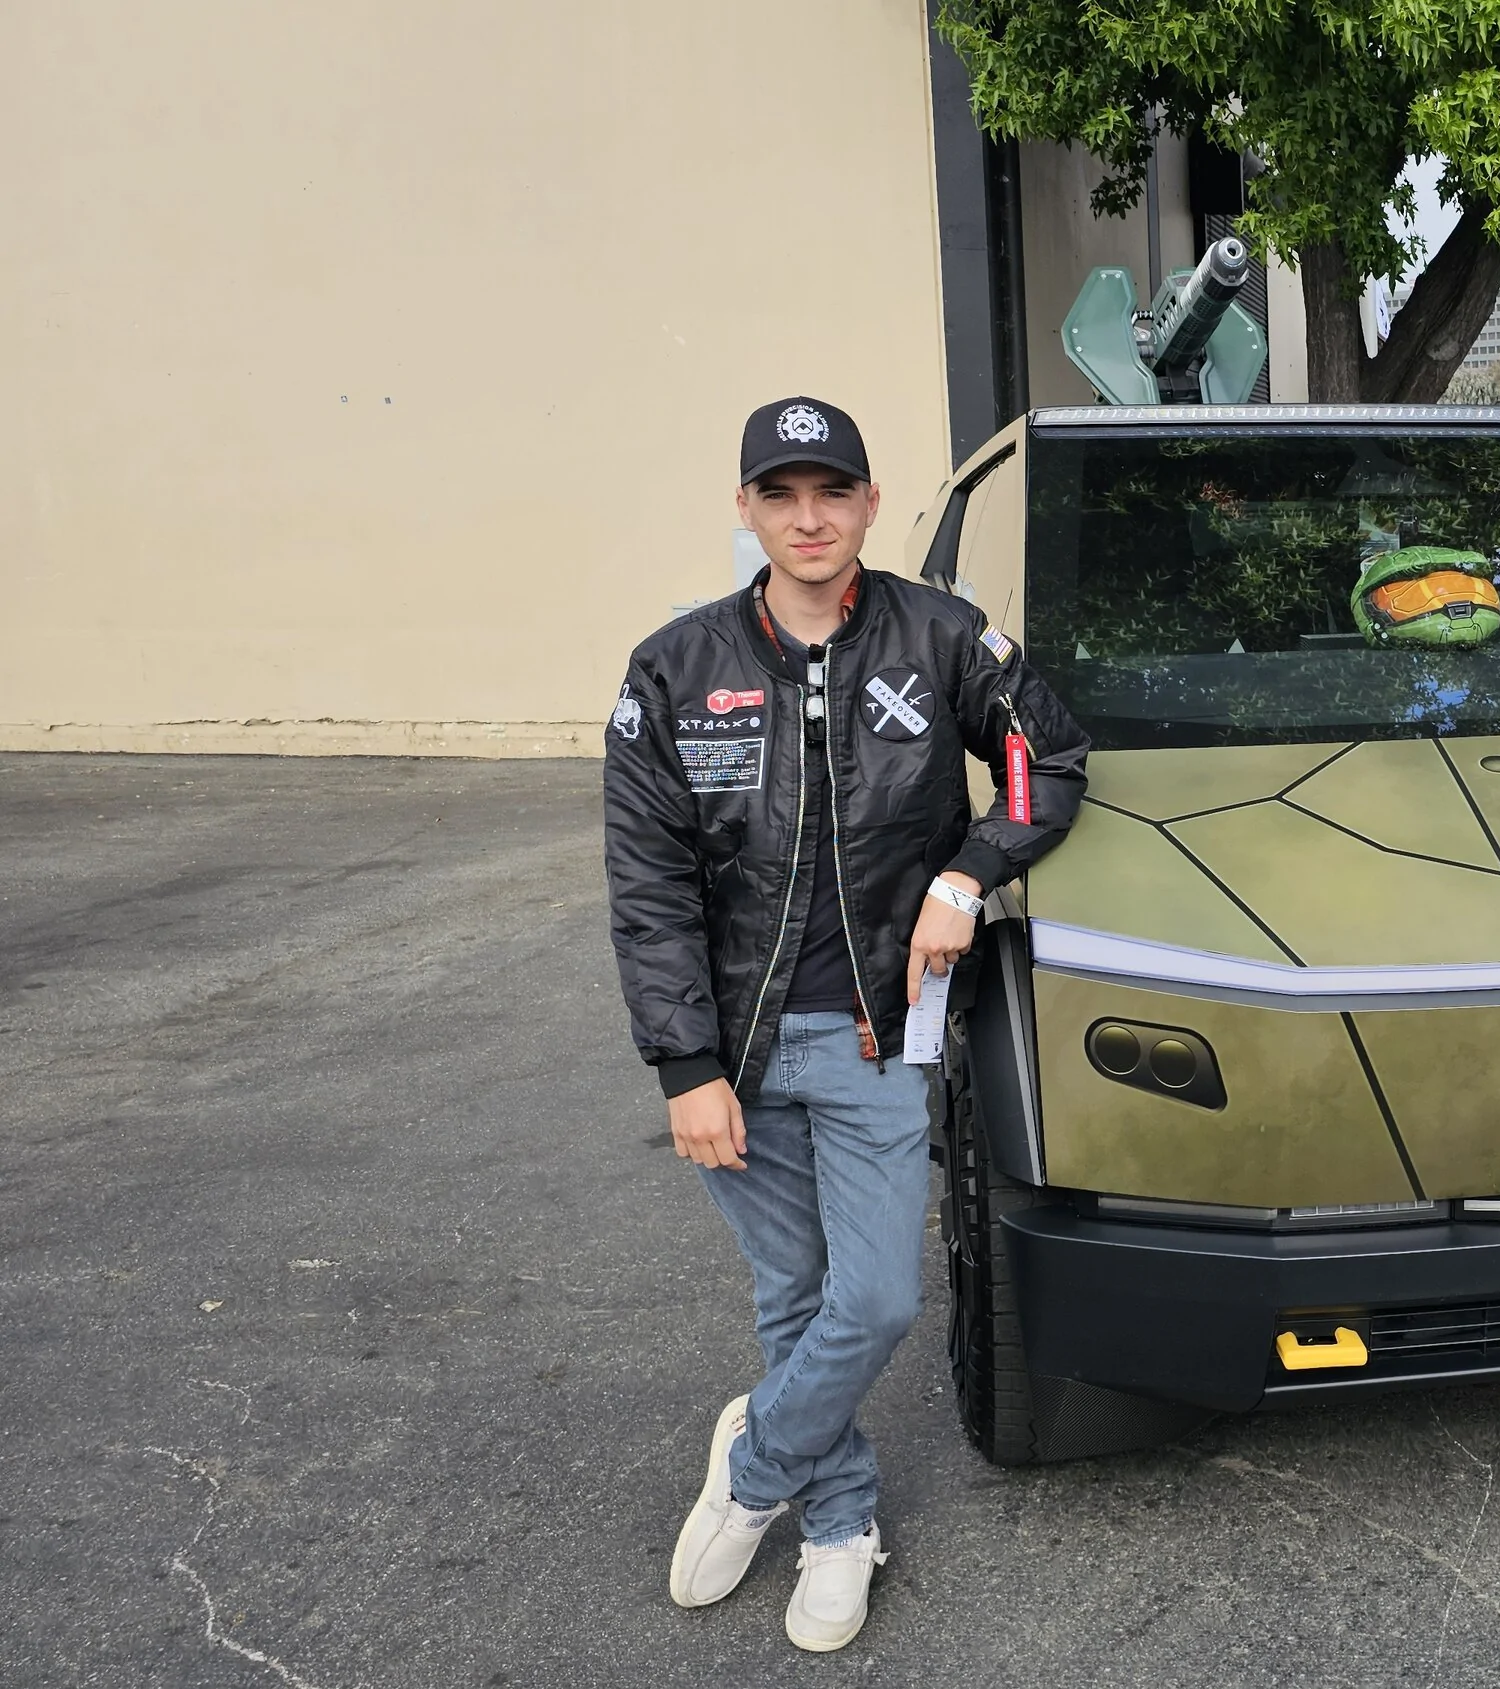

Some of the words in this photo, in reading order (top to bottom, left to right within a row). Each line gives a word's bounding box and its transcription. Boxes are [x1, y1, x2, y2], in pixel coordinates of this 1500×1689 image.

[875, 685, 920, 727] TAKEOVER
[1013, 749, 1023, 775] REMOVE
[1014, 775, 1024, 798] BEFORE
[1015, 799, 1025, 821] FLIGHT
